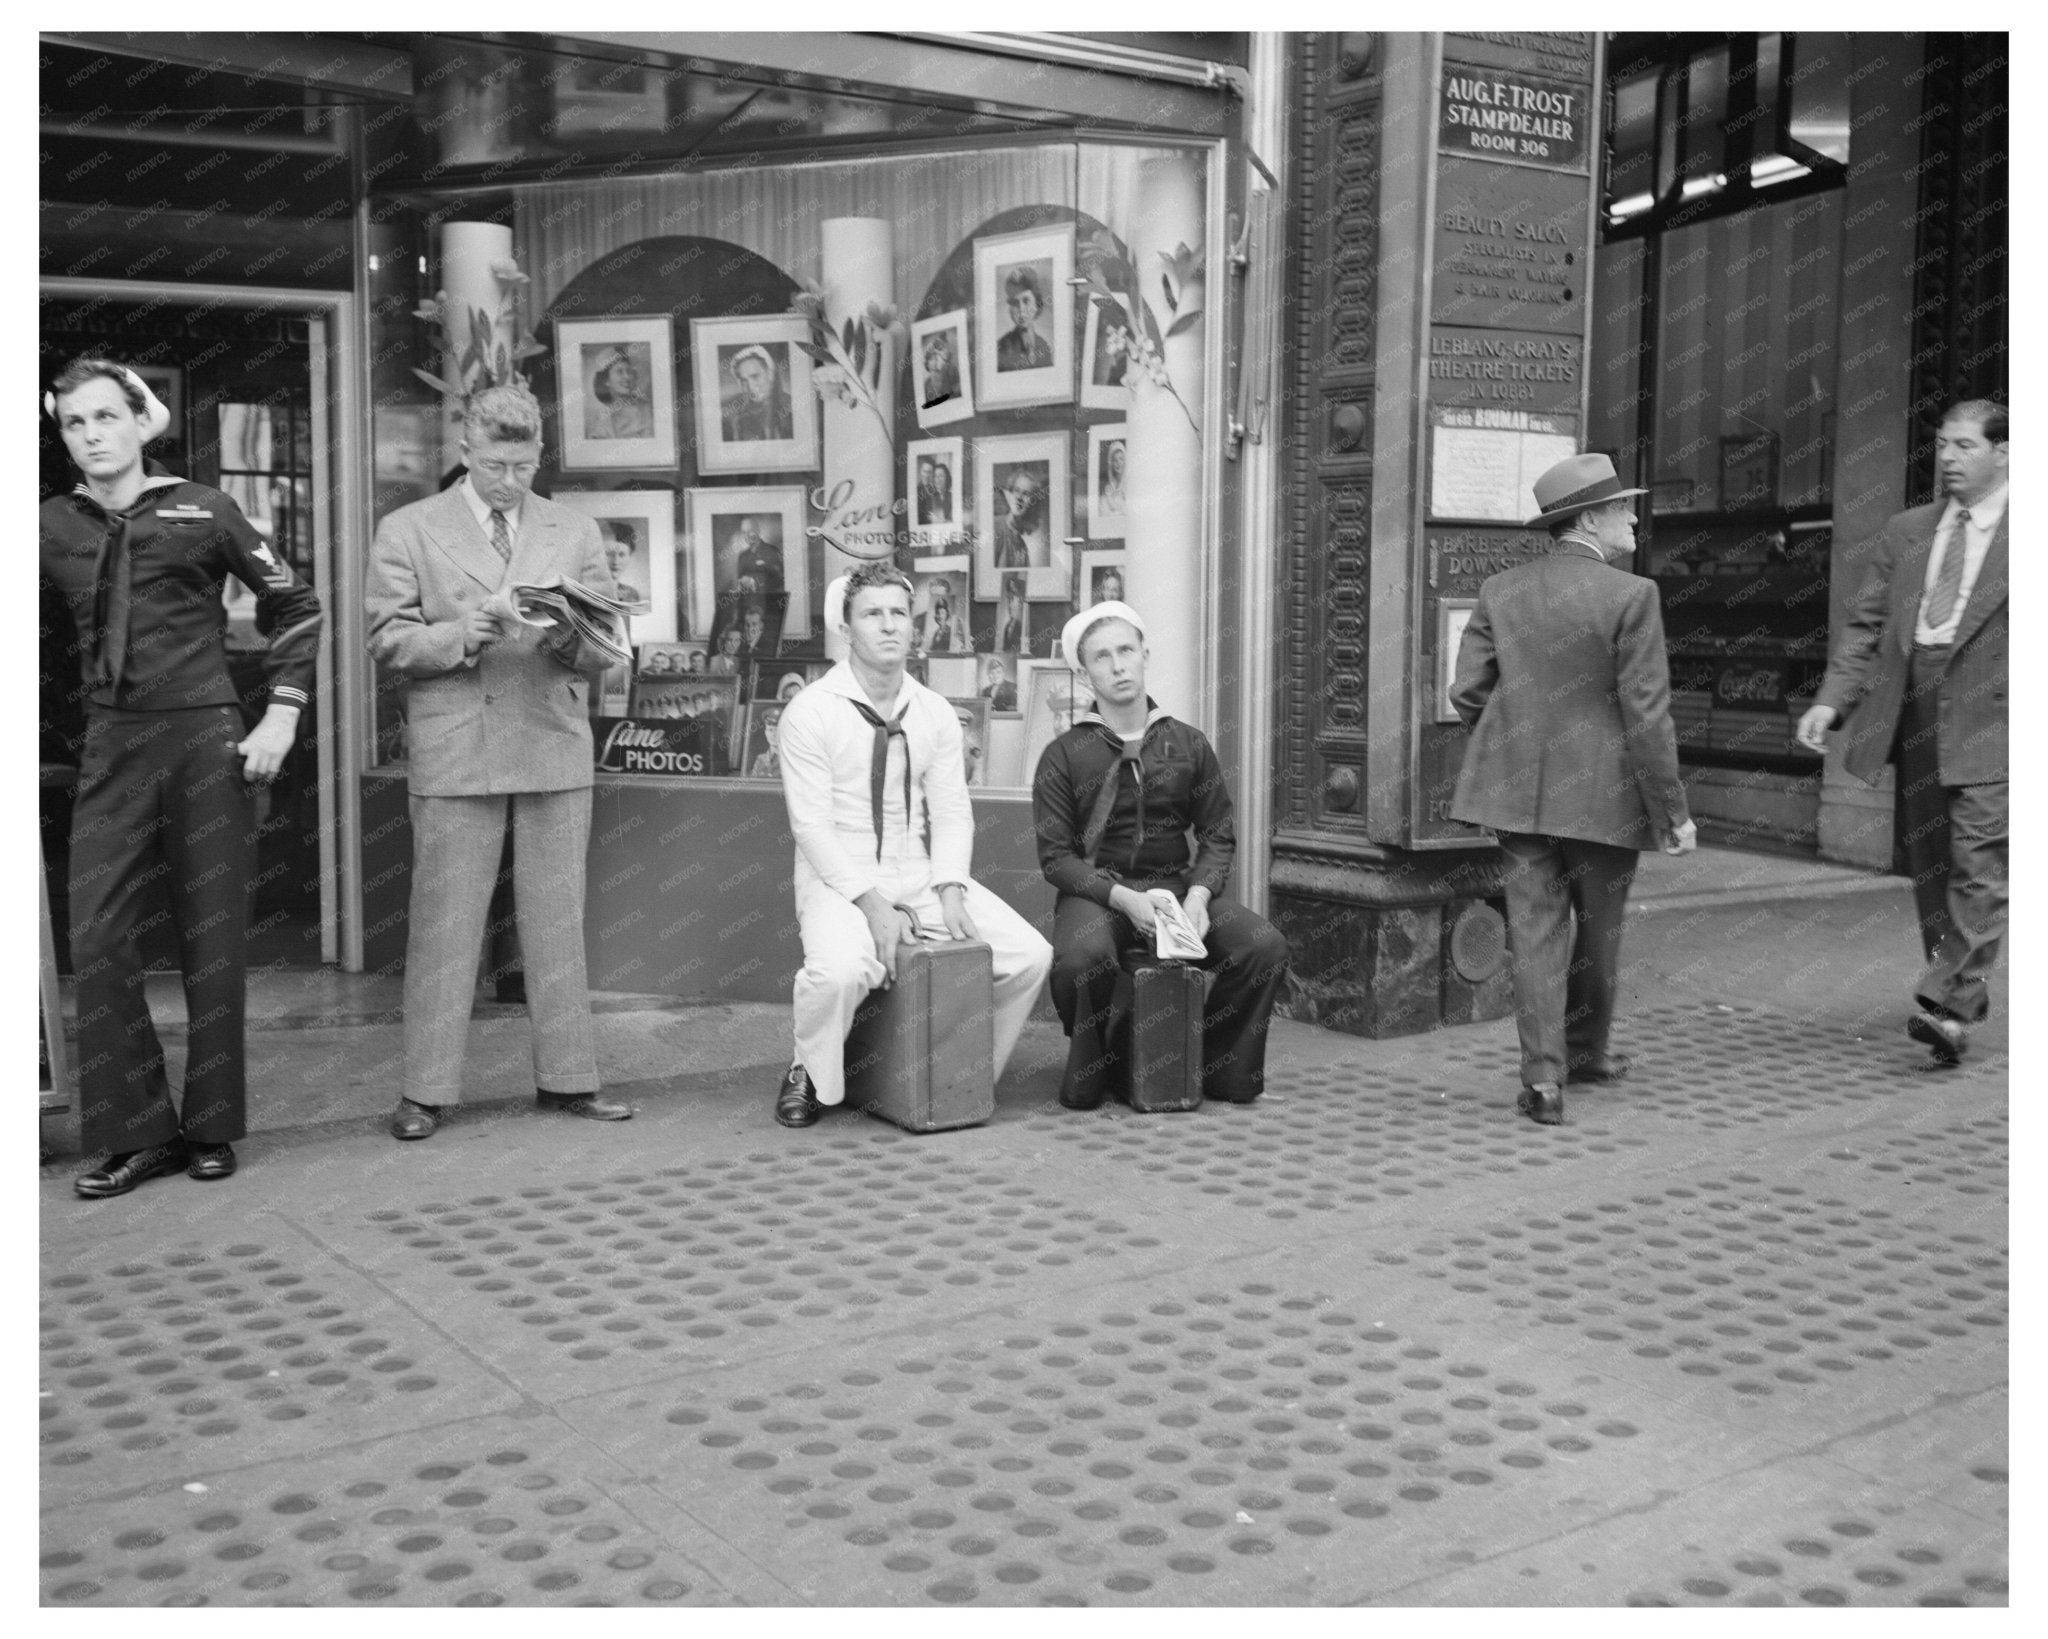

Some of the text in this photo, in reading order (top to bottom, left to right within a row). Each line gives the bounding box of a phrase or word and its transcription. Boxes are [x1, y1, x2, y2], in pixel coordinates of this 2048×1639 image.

[1470, 131, 1550, 157] ROOM 306
[1444, 213, 1568, 245] BEAUTY SALON
[1430, 360, 1575, 384] THEATRE TICKETS
[806, 479, 907, 560] Lane
[1442, 535, 1512, 555] BARBER
[598, 719, 666, 772] Lane
[625, 750, 704, 772] PHOTOS
